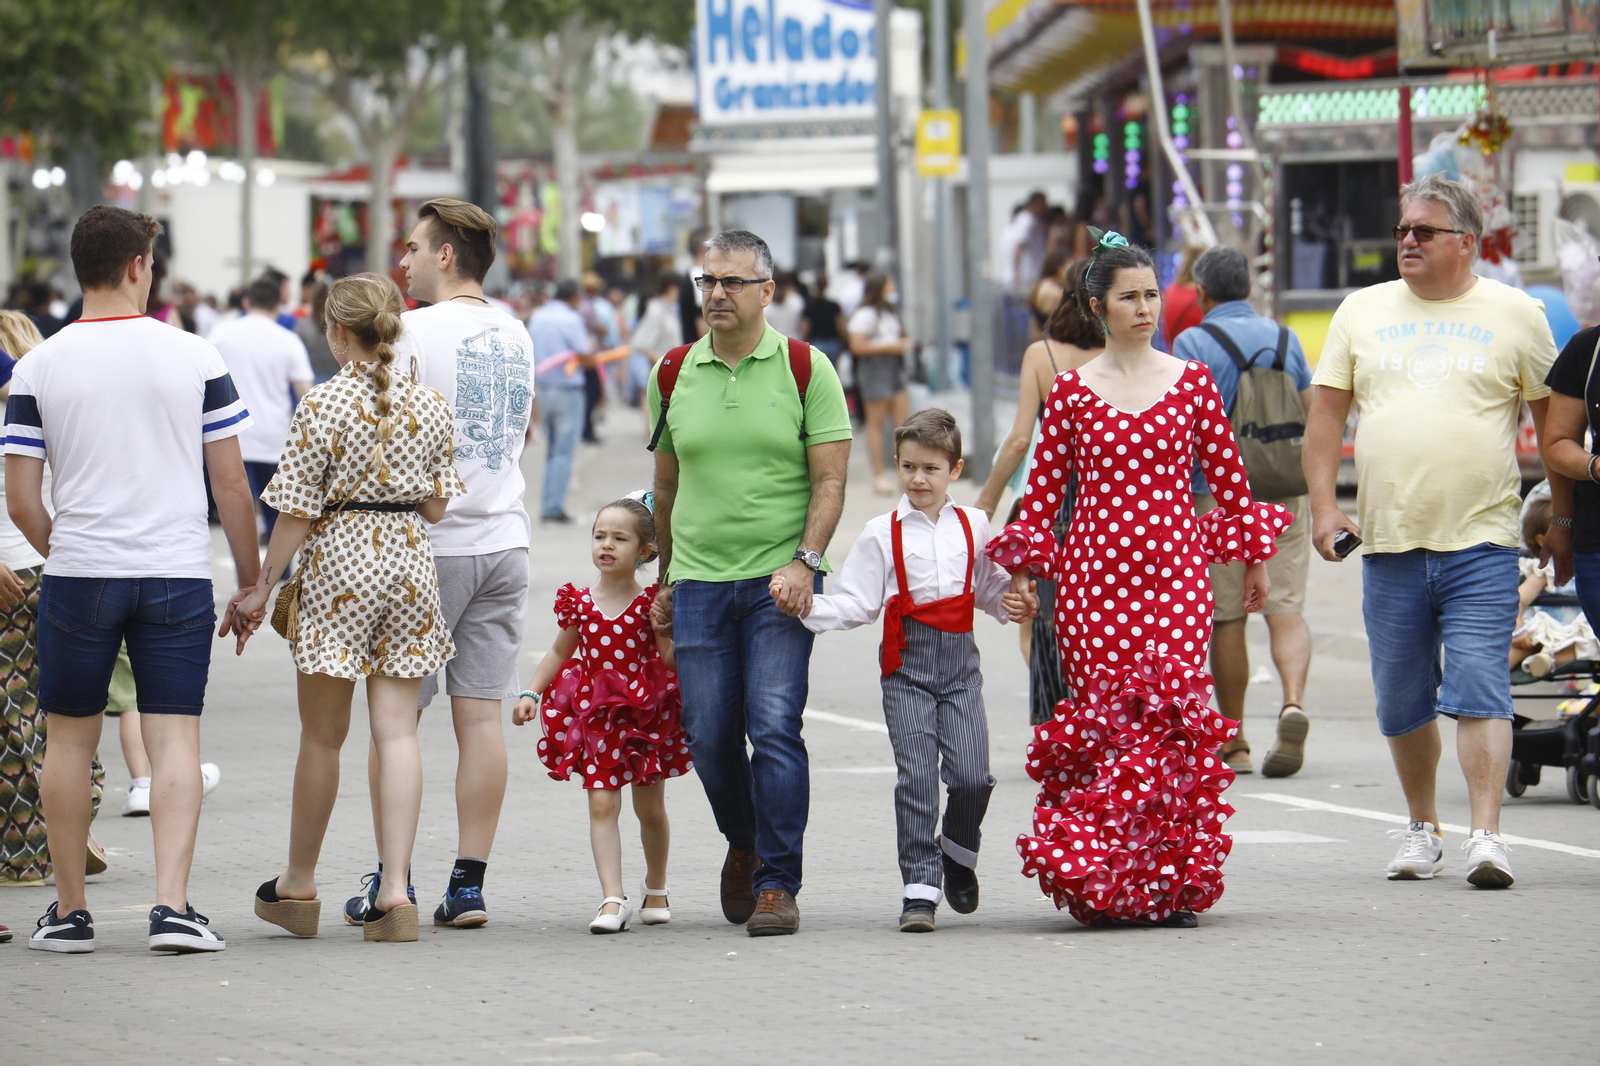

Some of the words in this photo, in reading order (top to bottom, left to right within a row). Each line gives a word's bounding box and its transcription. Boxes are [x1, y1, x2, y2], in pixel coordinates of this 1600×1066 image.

[1375, 322, 1417, 343] TOM
[1424, 321, 1495, 346] TAILOR
[1379, 352, 1404, 371] 19
[1457, 353, 1486, 374] 62
